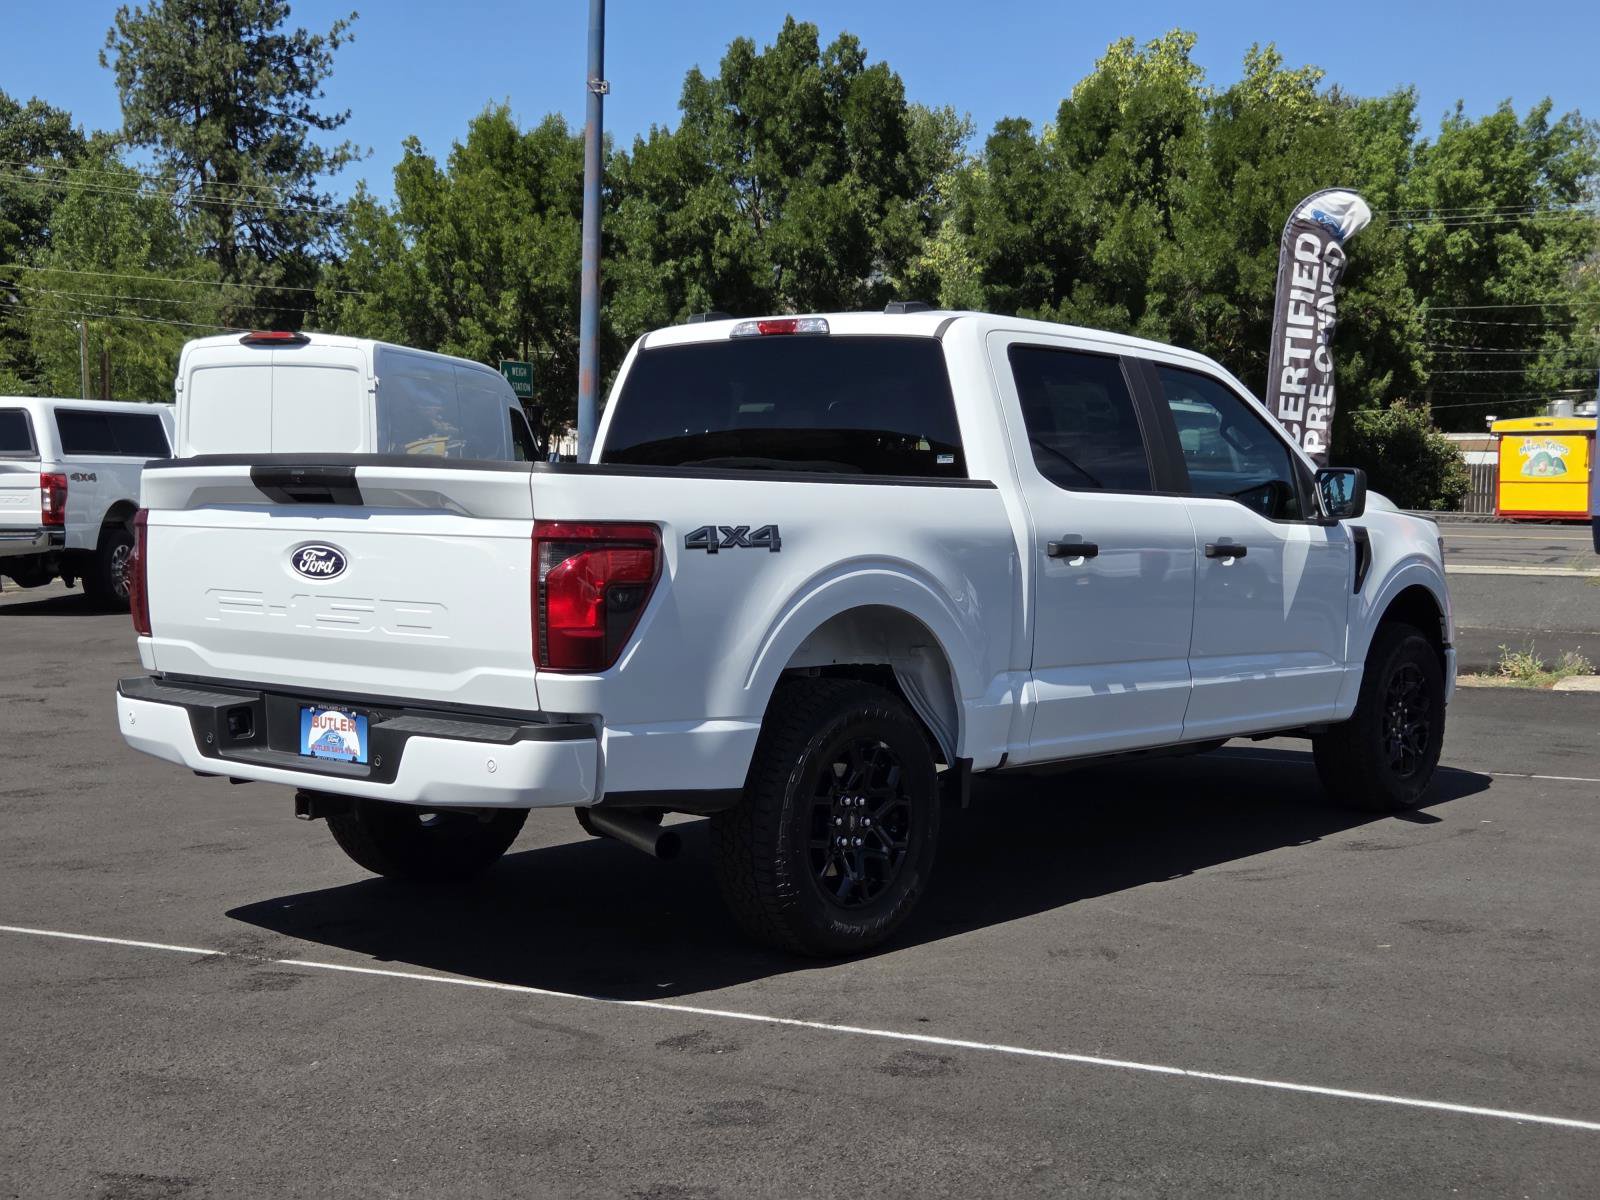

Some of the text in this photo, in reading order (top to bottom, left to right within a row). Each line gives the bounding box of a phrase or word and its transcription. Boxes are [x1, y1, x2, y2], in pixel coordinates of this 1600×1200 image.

[512, 367, 527, 376] WEIGH
[512, 382, 531, 392] STATION
[300, 549, 336, 573] Ford
[312, 716, 355, 732] BUTLER
